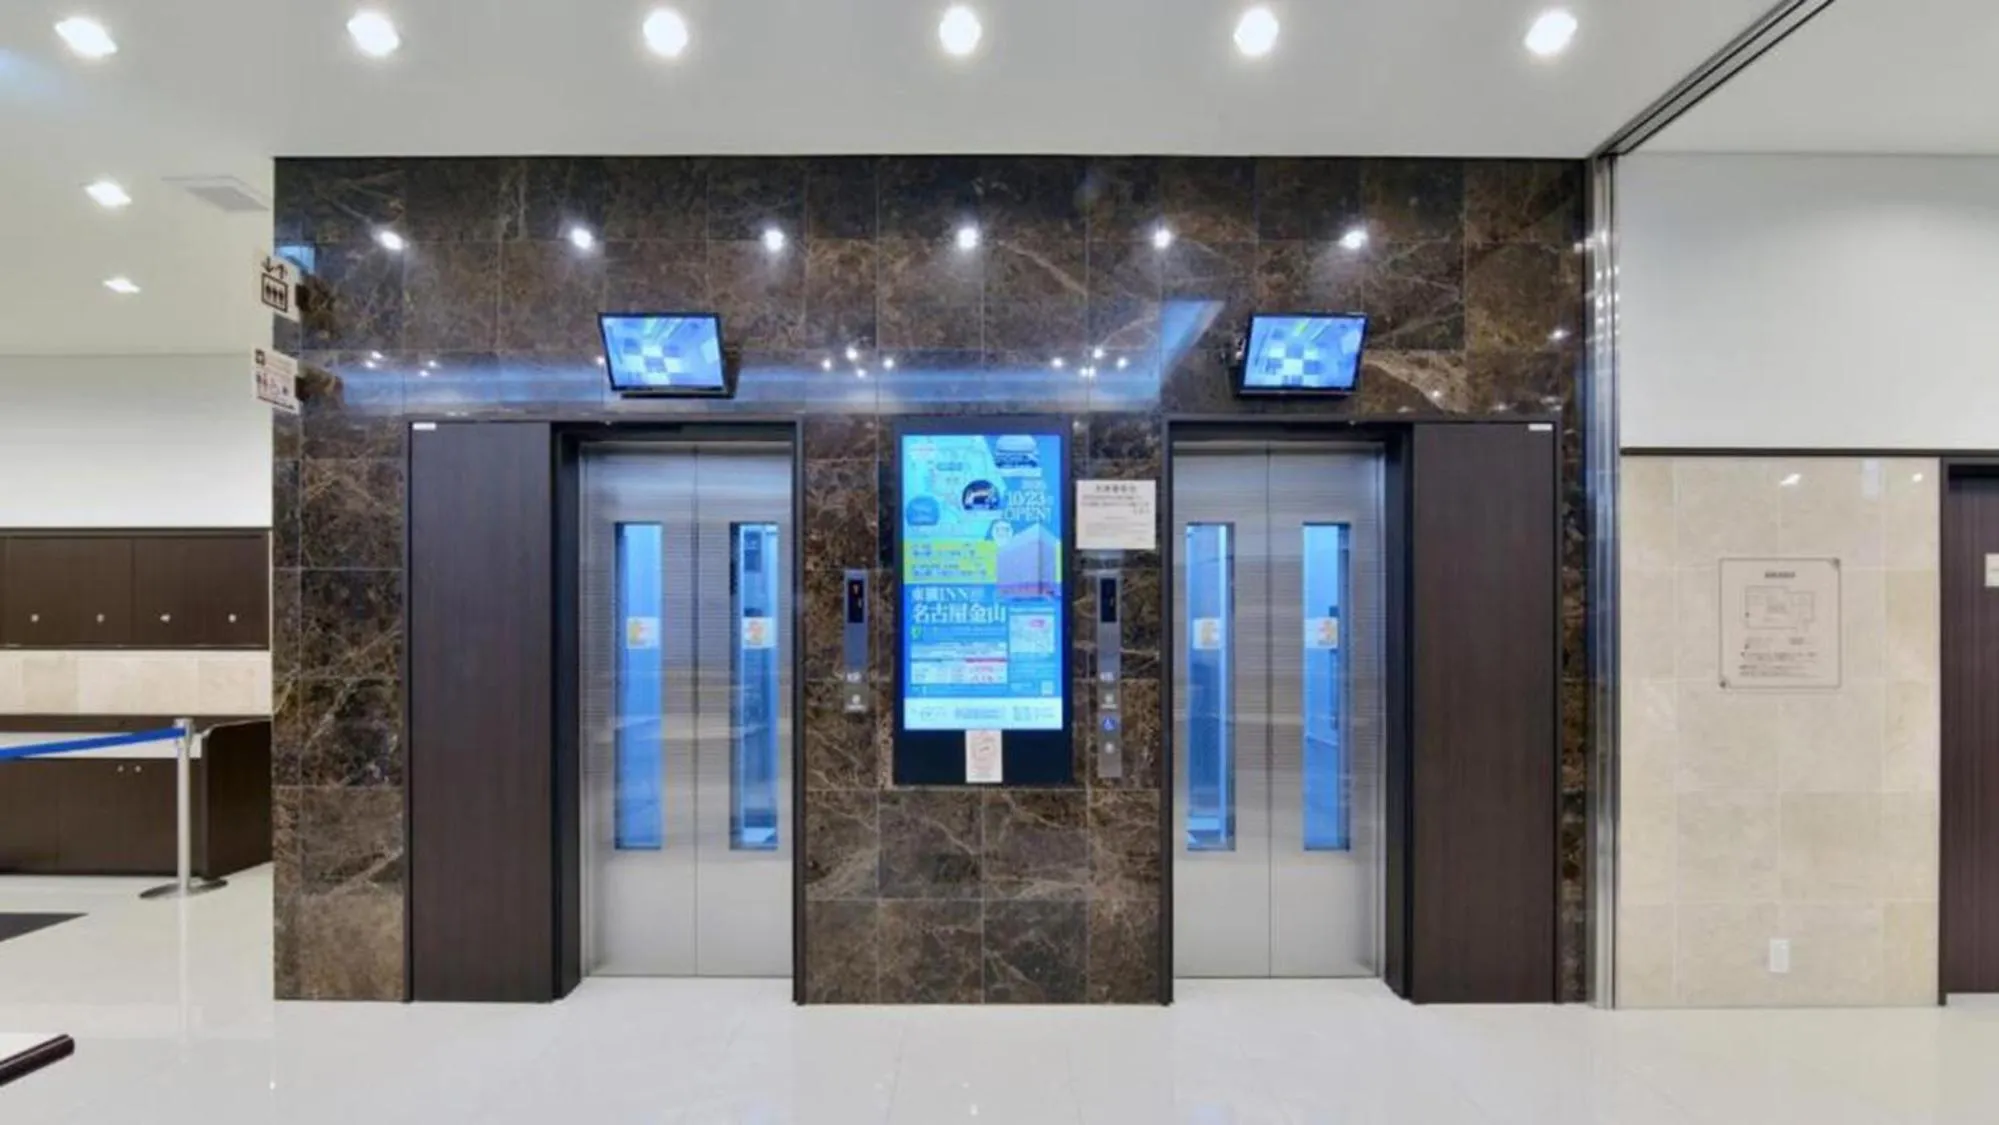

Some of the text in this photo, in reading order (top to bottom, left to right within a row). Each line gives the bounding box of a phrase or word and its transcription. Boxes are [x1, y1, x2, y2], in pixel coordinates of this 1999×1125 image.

[912, 602, 1007, 624] 名古屋金山
